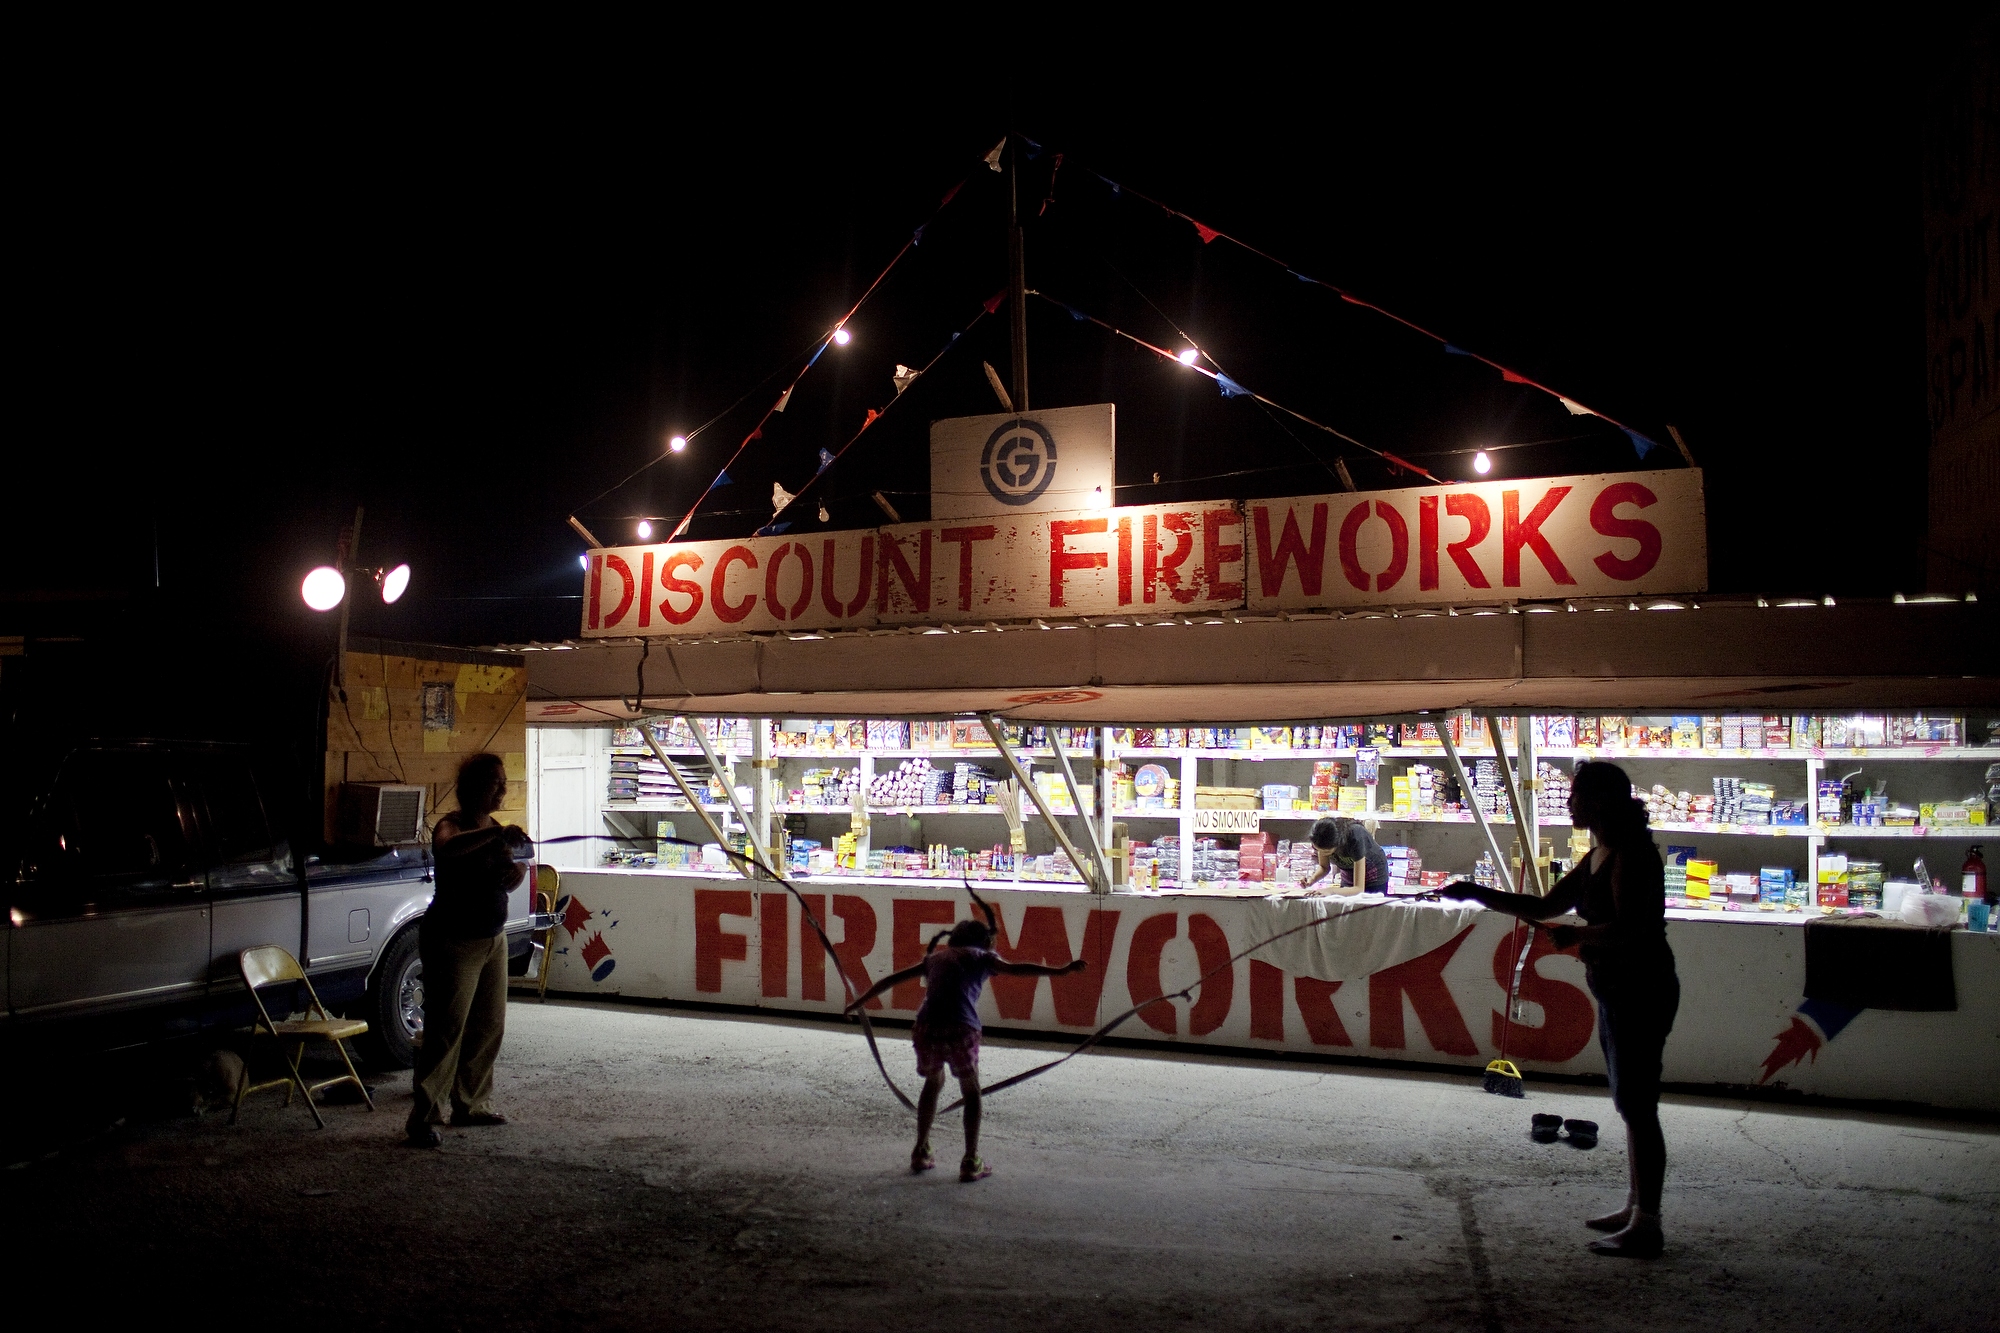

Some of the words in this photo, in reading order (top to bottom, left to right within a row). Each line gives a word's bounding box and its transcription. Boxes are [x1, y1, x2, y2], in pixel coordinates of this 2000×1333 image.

[996, 436, 1040, 488] G
[588, 524, 997, 630] DISCOUNT
[1049, 482, 1662, 608] FIREWORKS
[1195, 811, 1209, 828] NO
[1212, 811, 1258, 828] SMOKING
